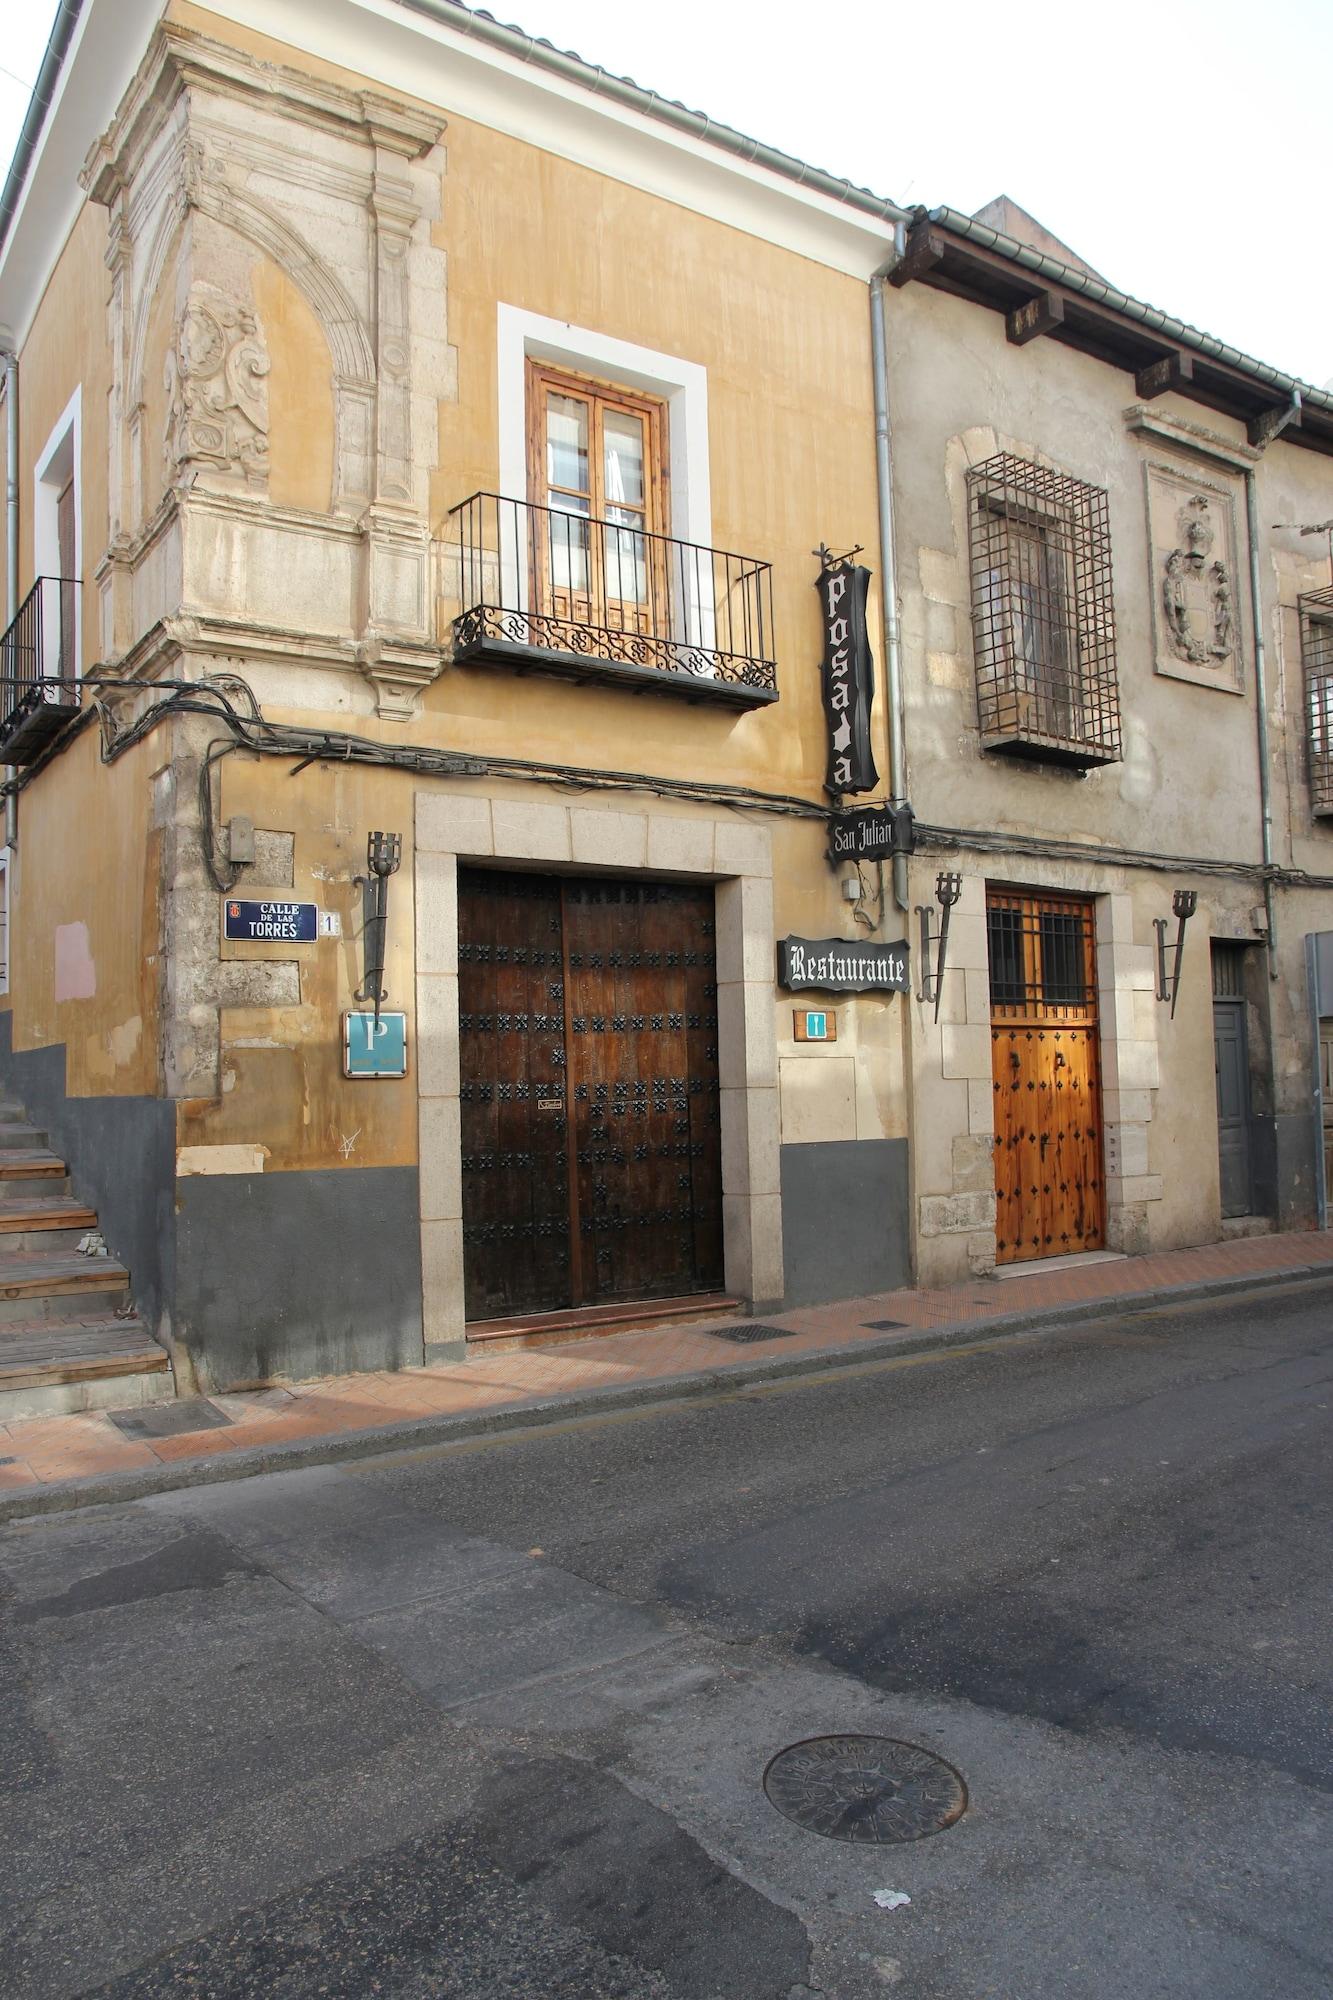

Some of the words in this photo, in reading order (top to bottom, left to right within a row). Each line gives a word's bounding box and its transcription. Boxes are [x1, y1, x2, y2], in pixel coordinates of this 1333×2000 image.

[828, 574, 852, 786] posada
[834, 826, 855, 852] San
[858, 819, 892, 851] Julián
[260, 904, 300, 915] CALLE
[260, 914, 273, 922] DE
[277, 914, 294, 923] LAS
[249, 922, 297, 938] TORRES
[325, 916, 332, 931] 1
[790, 945, 905, 982] Restaurante
[364, 1020, 388, 1051] P
